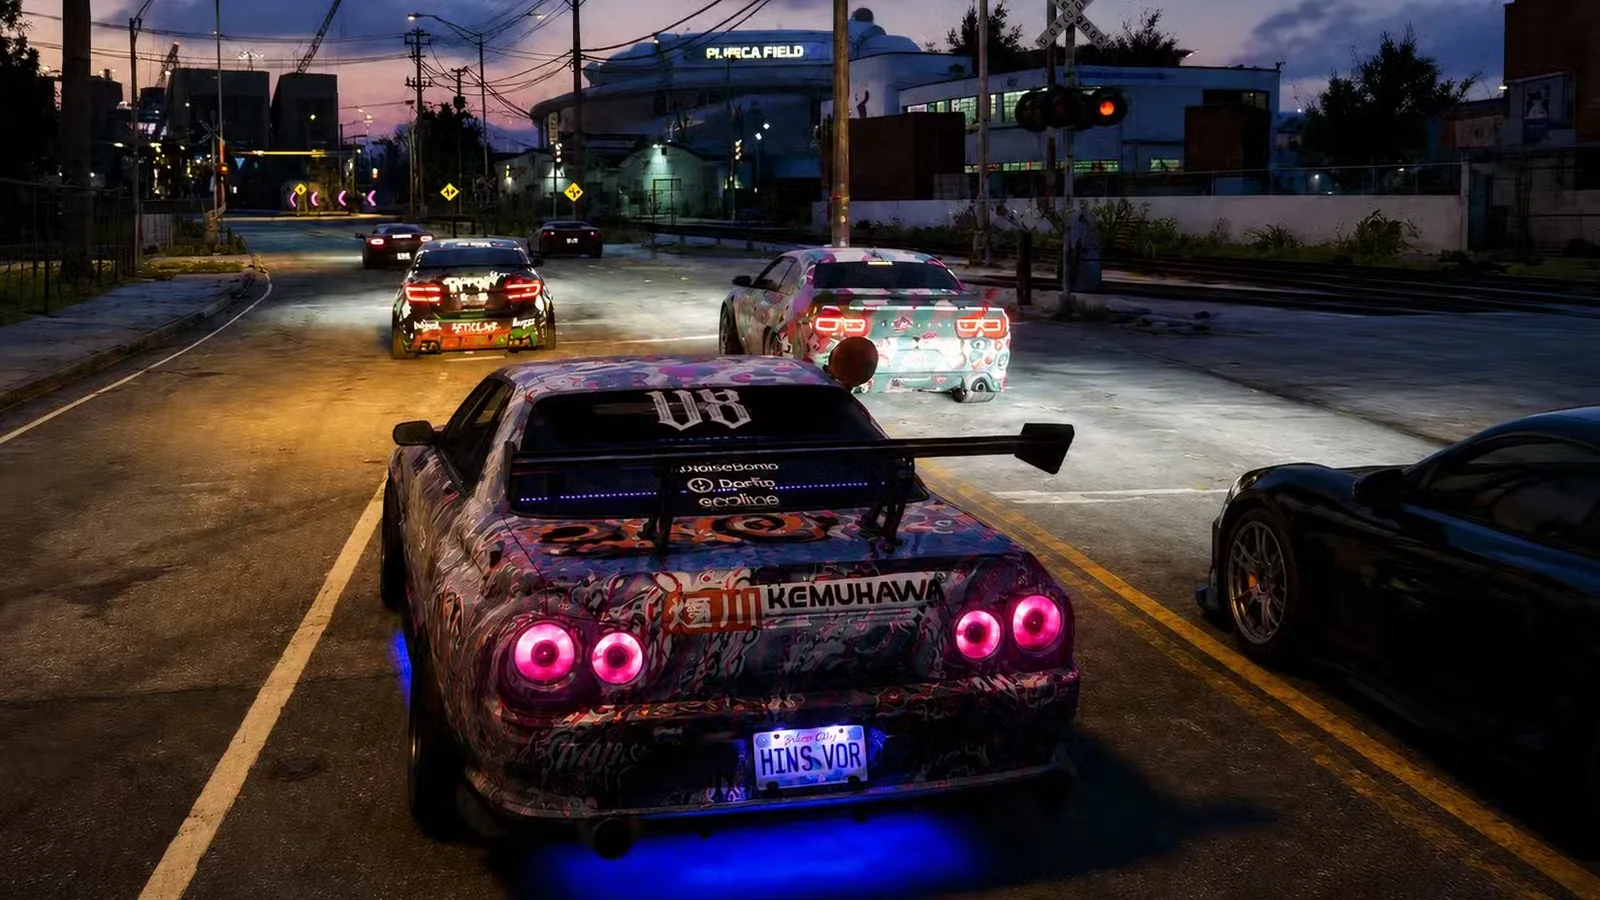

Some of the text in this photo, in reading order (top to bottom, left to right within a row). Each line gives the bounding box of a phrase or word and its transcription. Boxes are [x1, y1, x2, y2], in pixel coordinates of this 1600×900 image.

[763, 45, 805, 59] FIELD
[760, 742, 862, 776] HINS VOR
